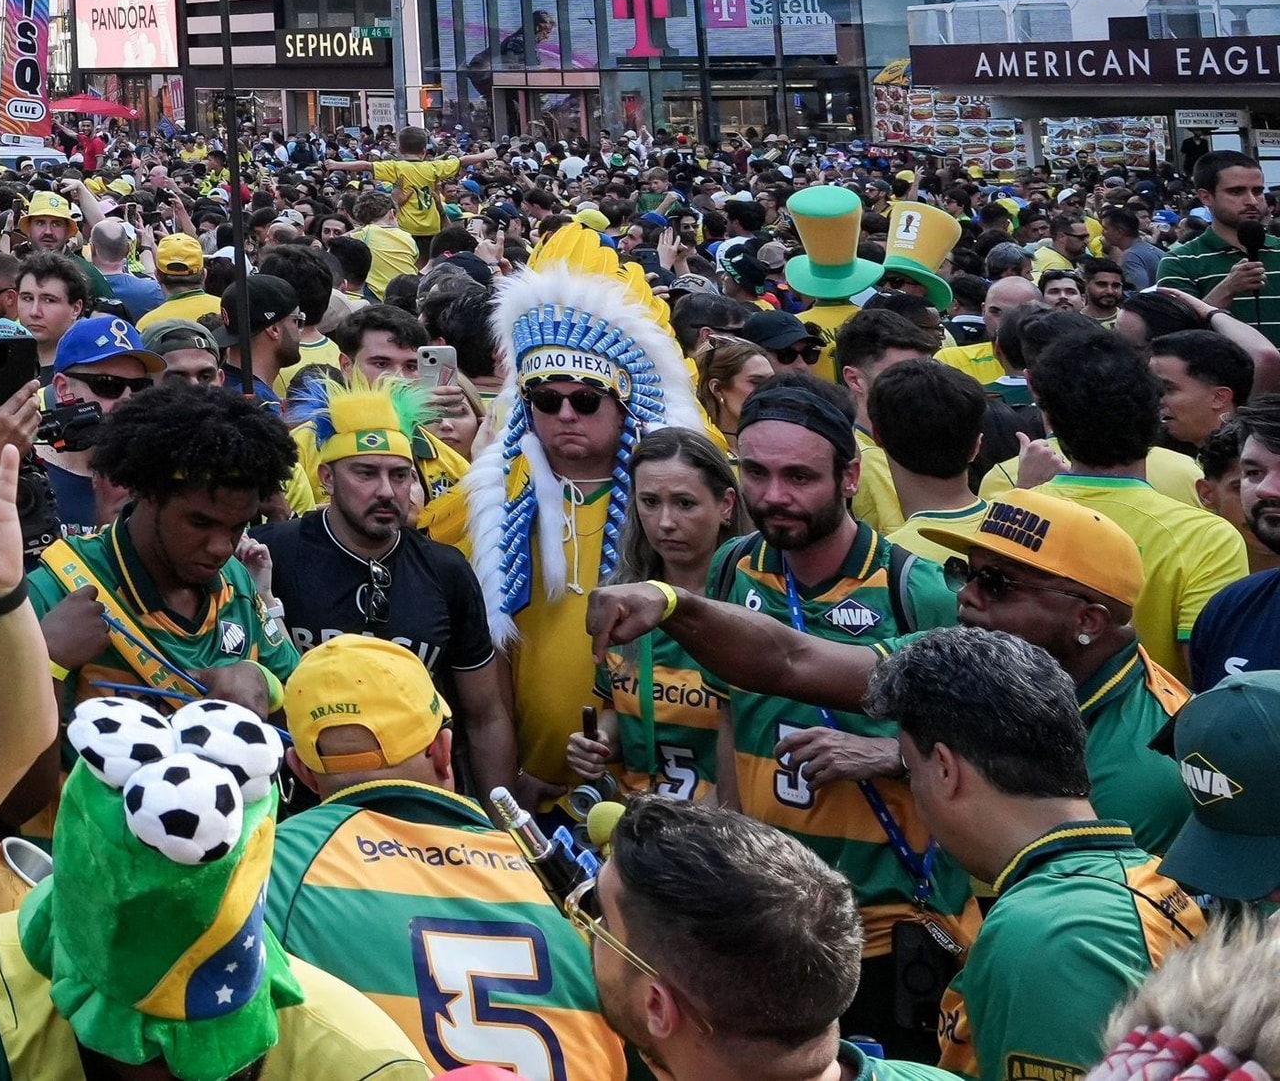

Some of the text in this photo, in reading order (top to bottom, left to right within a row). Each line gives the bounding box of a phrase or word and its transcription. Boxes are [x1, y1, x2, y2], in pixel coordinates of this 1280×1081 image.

[91, 4, 158, 31] PANDORA
[285, 31, 373, 58] SEPHORA
[361, 28, 382, 37] W 46
[975, 48, 1150, 79] AMERICAN
[14, 104, 38, 115] LIVE
[545, 353, 612, 378] AO HEXA
[78, 405, 96, 414] SONY
[832, 608, 875, 626] MVA
[309, 703, 361, 721] BRASIL
[1181, 759, 1234, 799] MVA
[407, 915, 569, 1081] 5
